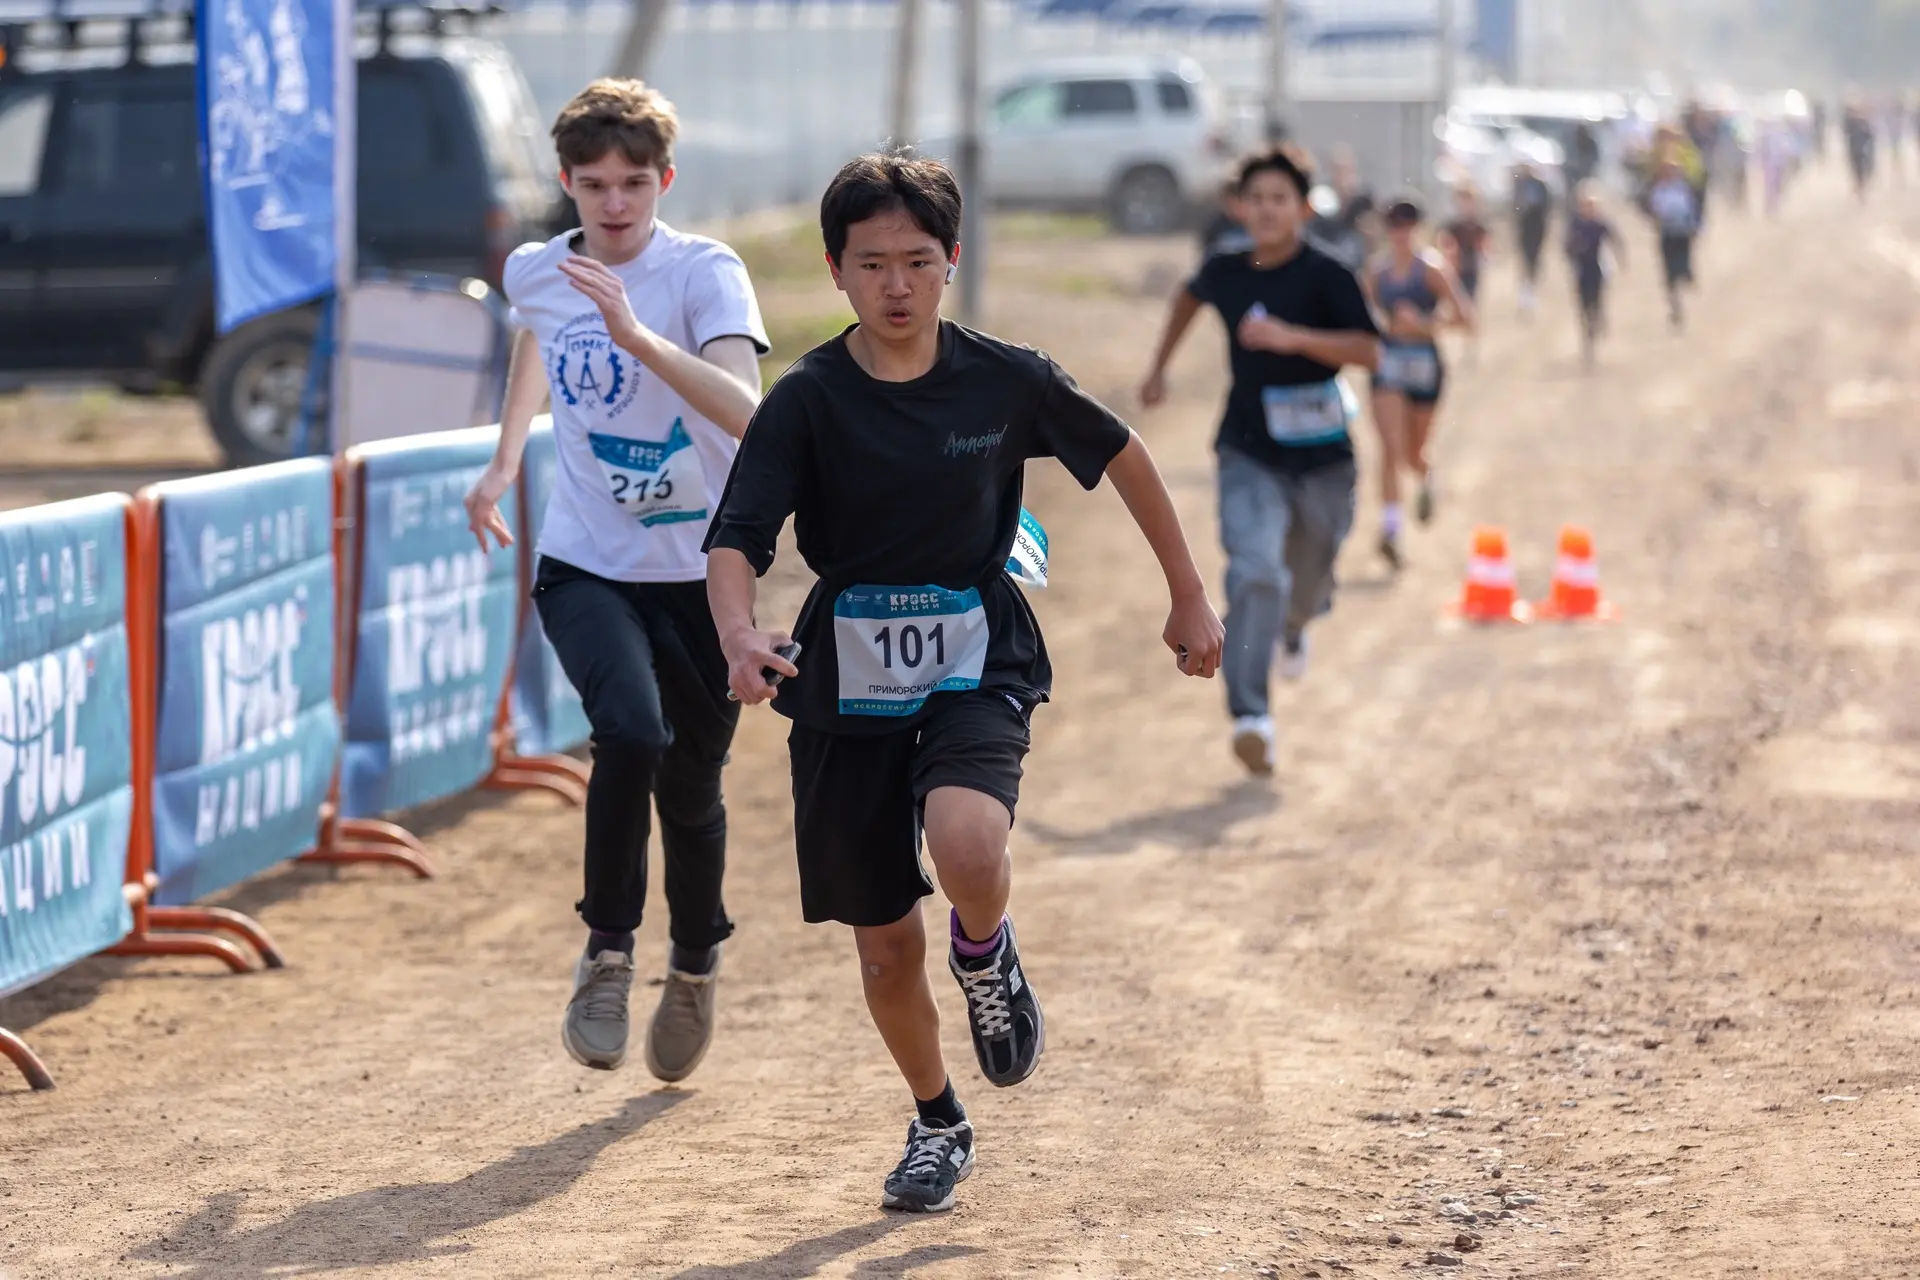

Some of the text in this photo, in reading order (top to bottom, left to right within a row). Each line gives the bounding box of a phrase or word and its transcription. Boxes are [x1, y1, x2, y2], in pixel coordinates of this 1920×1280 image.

[889, 592, 939, 606] КРОСС
[890, 603, 940, 612] НАЦИИ
[874, 622, 945, 669] 101
[868, 680, 937, 695] ПРИМОРСКИЙ
